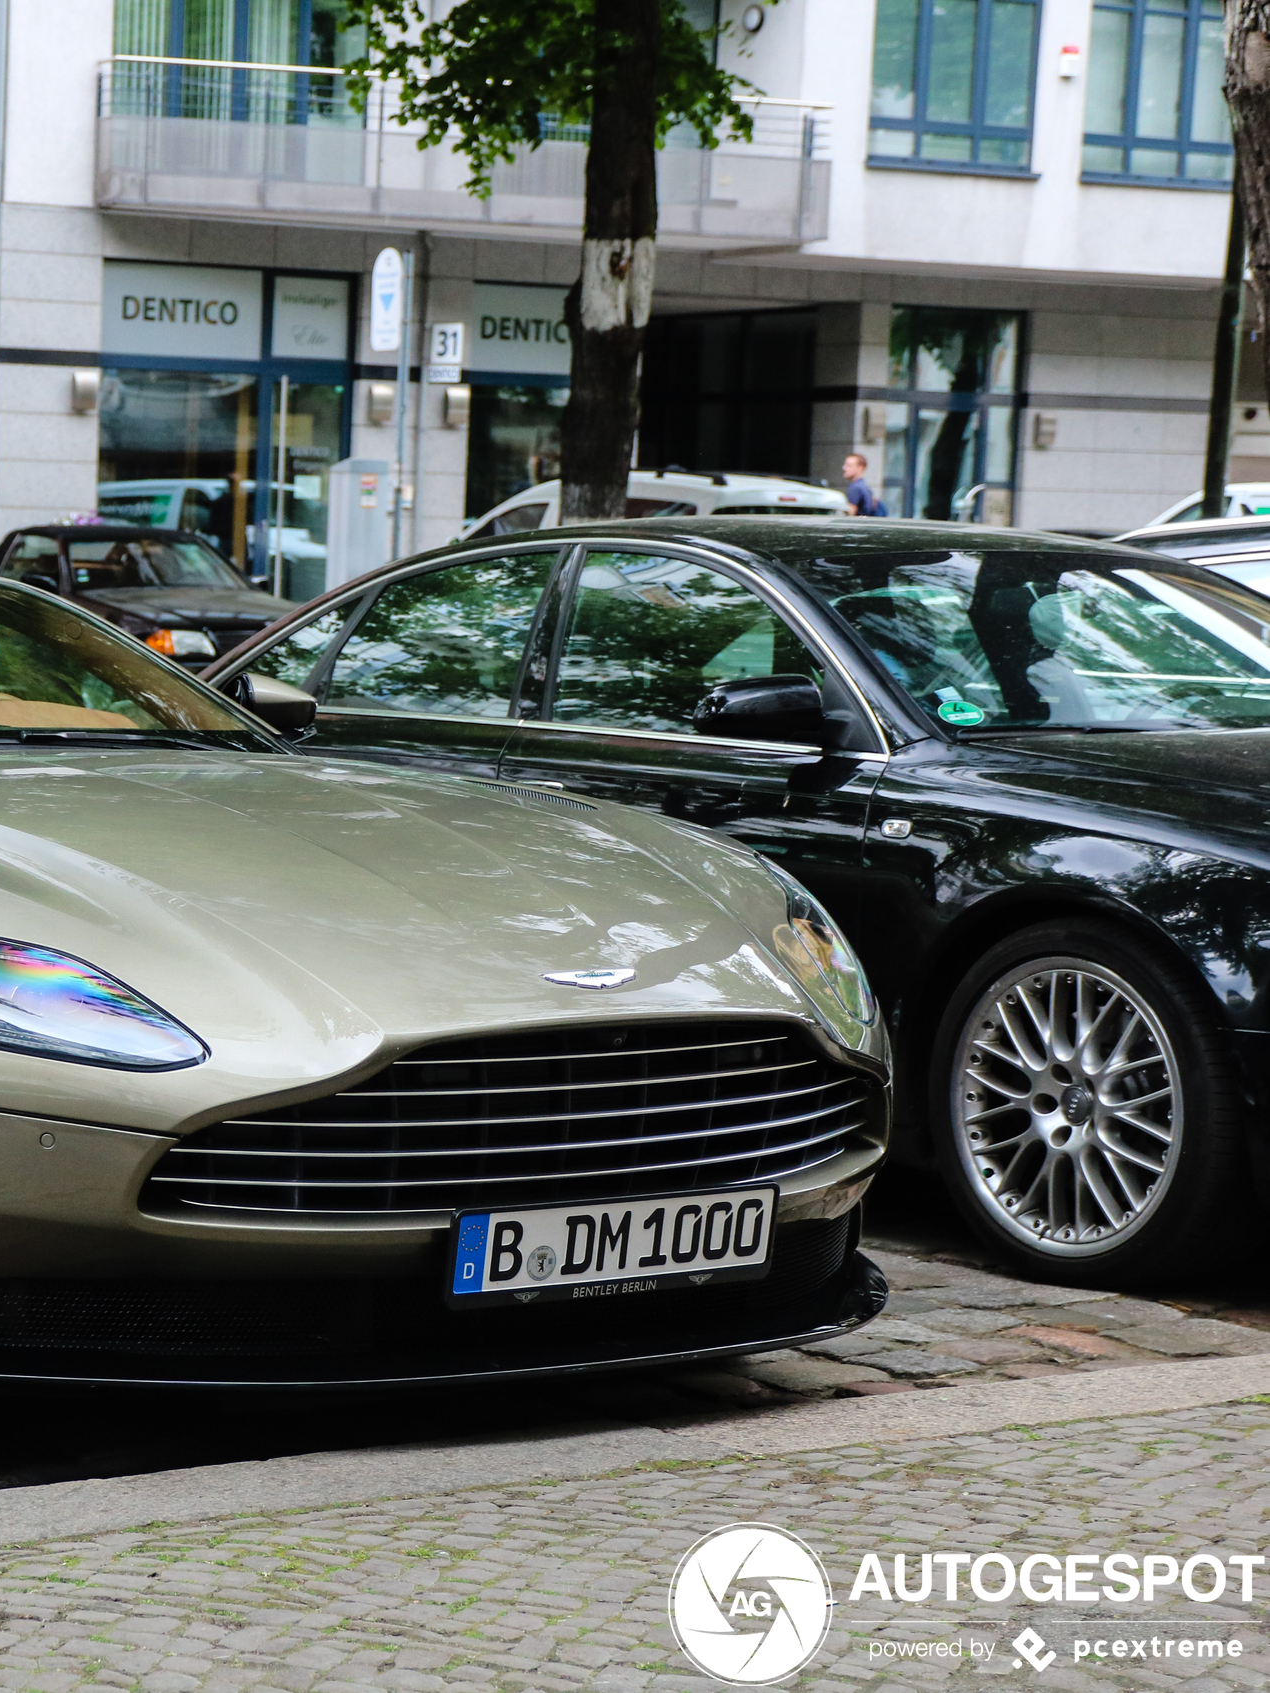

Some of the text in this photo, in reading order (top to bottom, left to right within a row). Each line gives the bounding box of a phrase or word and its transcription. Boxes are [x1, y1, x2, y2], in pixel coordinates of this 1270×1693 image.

[122, 296, 238, 325] DENTICO
[480, 316, 570, 344] DENTIC
[437, 331, 458, 356] 31
[953, 703, 965, 713] 4
[489, 1221, 524, 1282] B
[560, 1211, 632, 1276] DM
[638, 1199, 764, 1268] 1000
[463, 1262, 475, 1280] D
[572, 1279, 657, 1298] BENTLEY BERLIN
